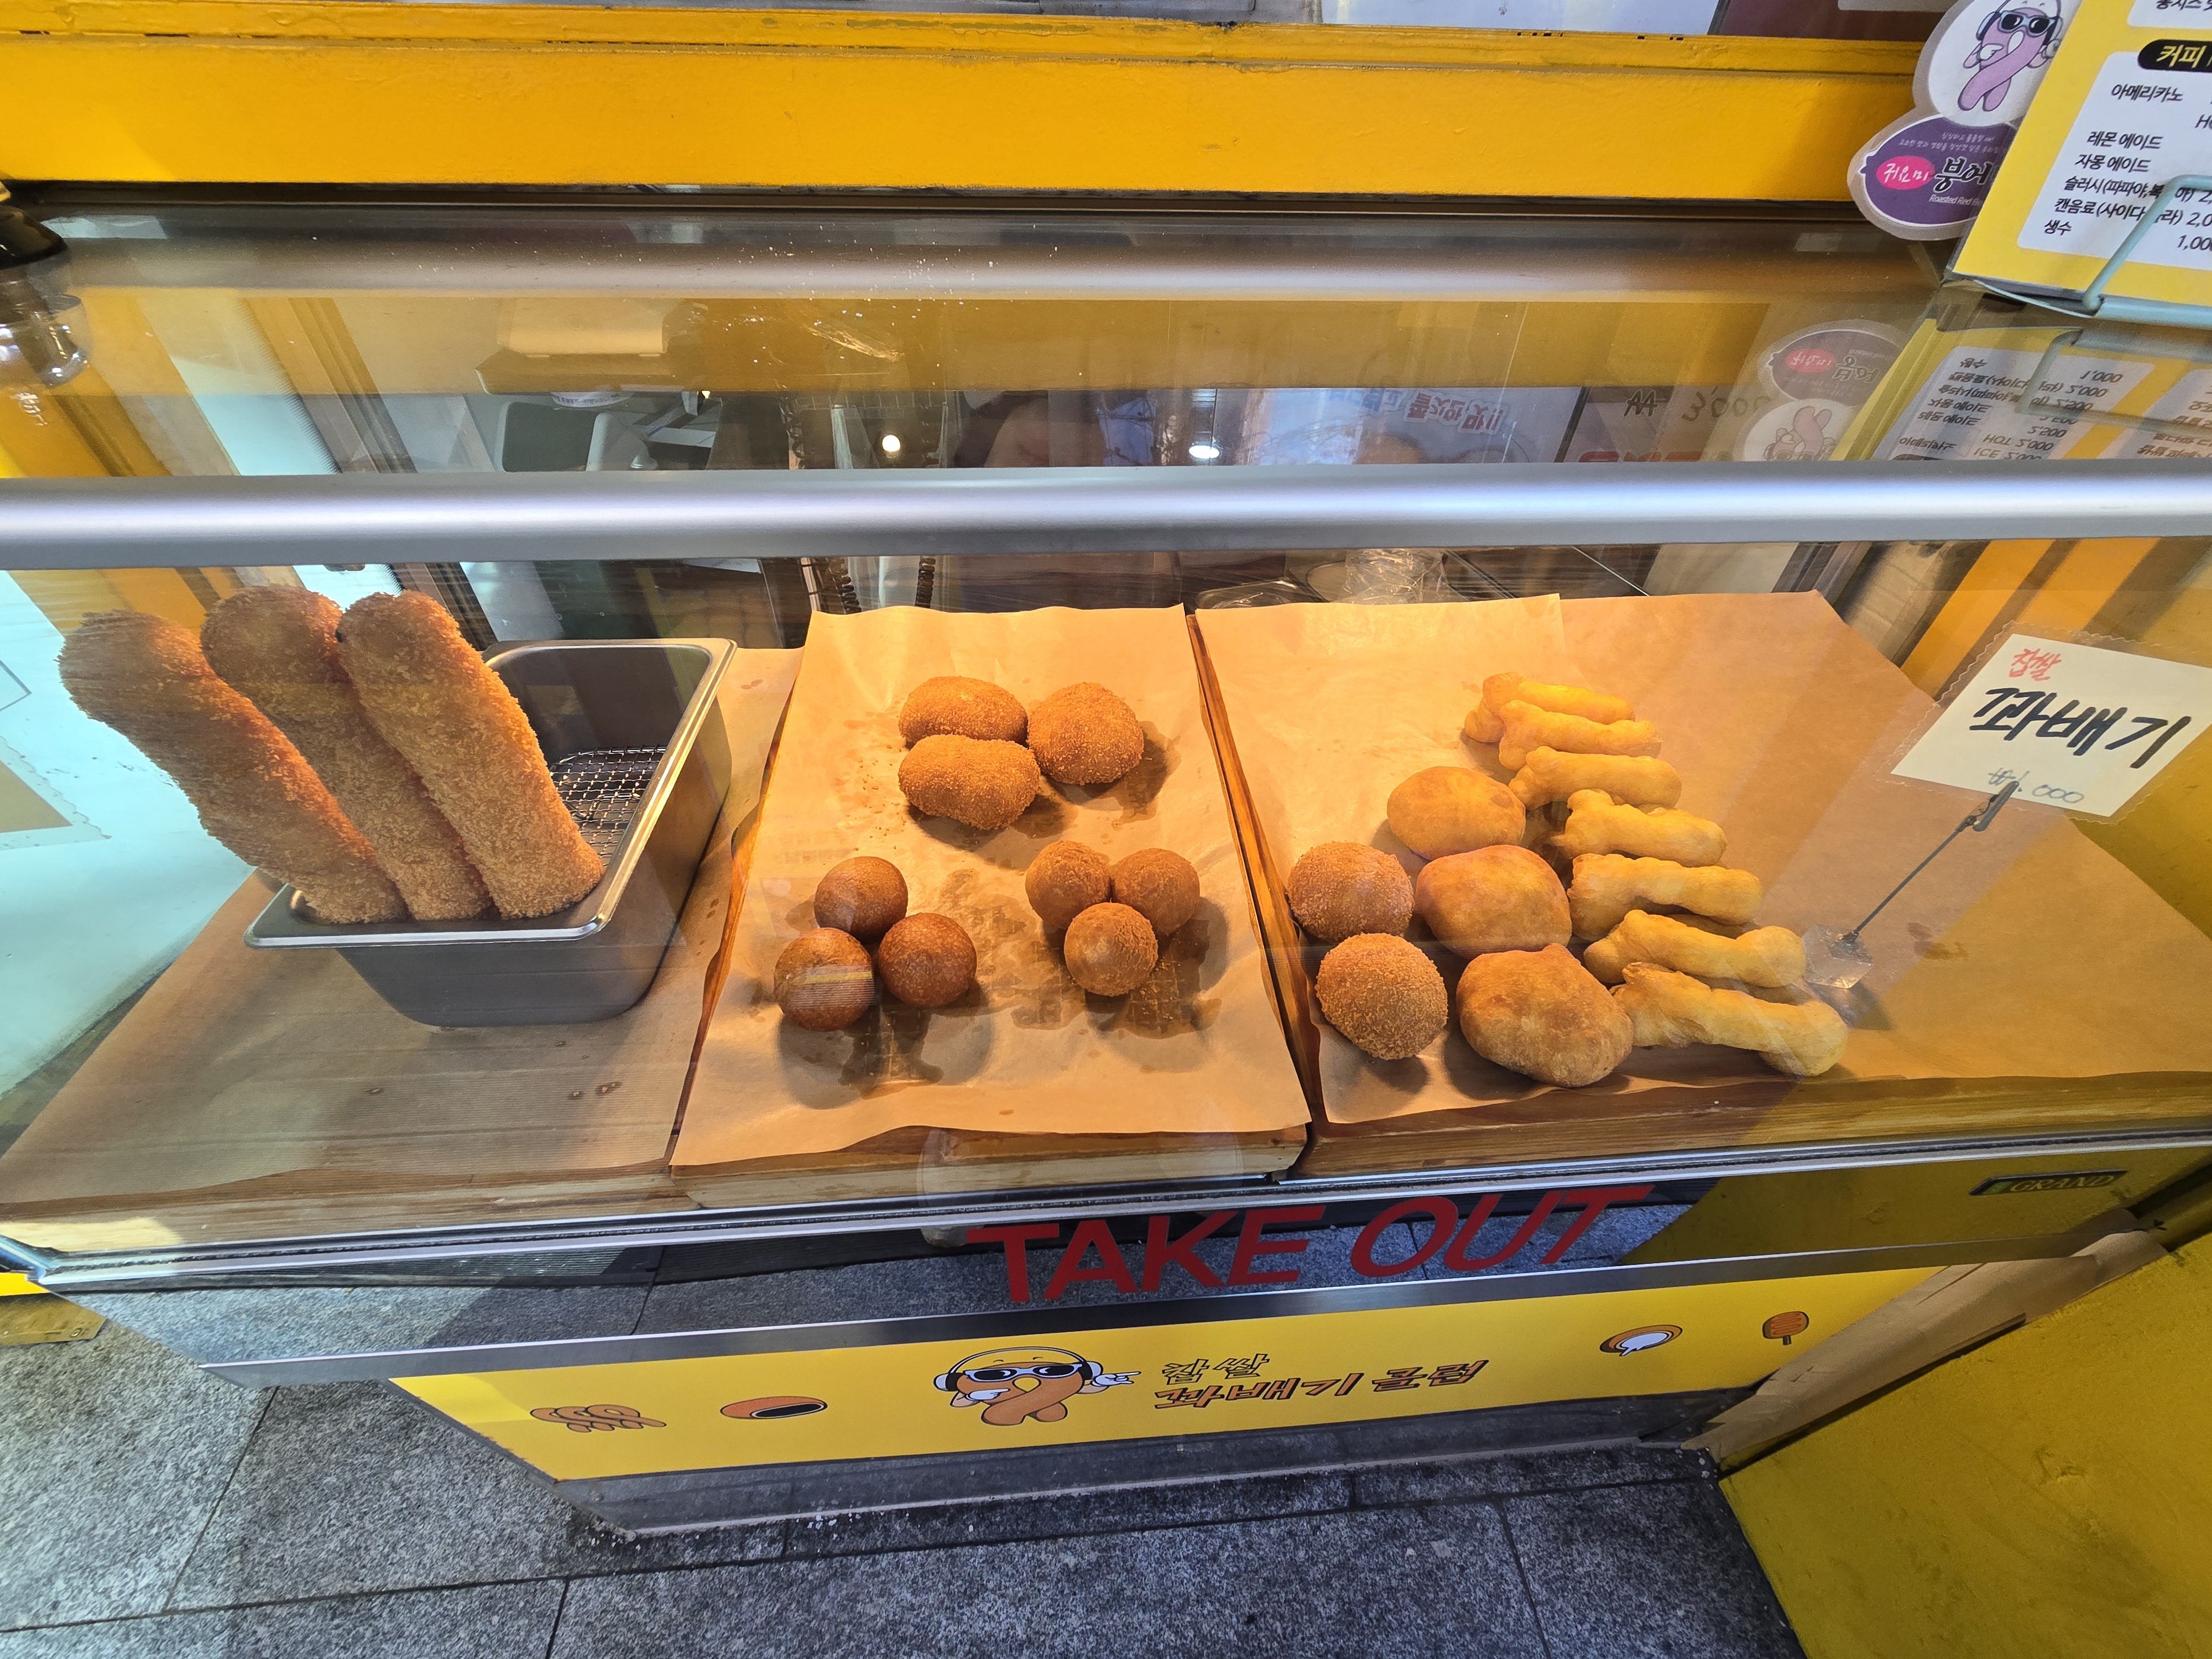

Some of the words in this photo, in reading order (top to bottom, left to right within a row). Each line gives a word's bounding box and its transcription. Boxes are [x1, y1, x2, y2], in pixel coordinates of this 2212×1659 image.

[2156, 44, 2206, 68] 커피
[2111, 84, 2184, 103] 아메리카노
[2086, 131, 2118, 147] 레몬
[2118, 133, 2164, 150] 에이드
[2074, 154, 2106, 170] 자몽
[2106, 156, 2151, 173] 에이드
[1884, 163, 1930, 184] 귀요미
[1928, 194, 1958, 204] Roasted
[1957, 196, 1973, 205] Red
[2044, 219, 2073, 236] 생수
[2177, 235, 2212, 251] 1,00
[2008, 648, 2062, 681] 찹쌀
[1969, 687, 2192, 769] 꽈배기
[2010, 1176, 2115, 1192] GRAND
[967, 1206, 1327, 1302] TAKE
[1350, 1185, 1656, 1279] OUT
[1154, 1373, 1365, 1409] 꽈배기
